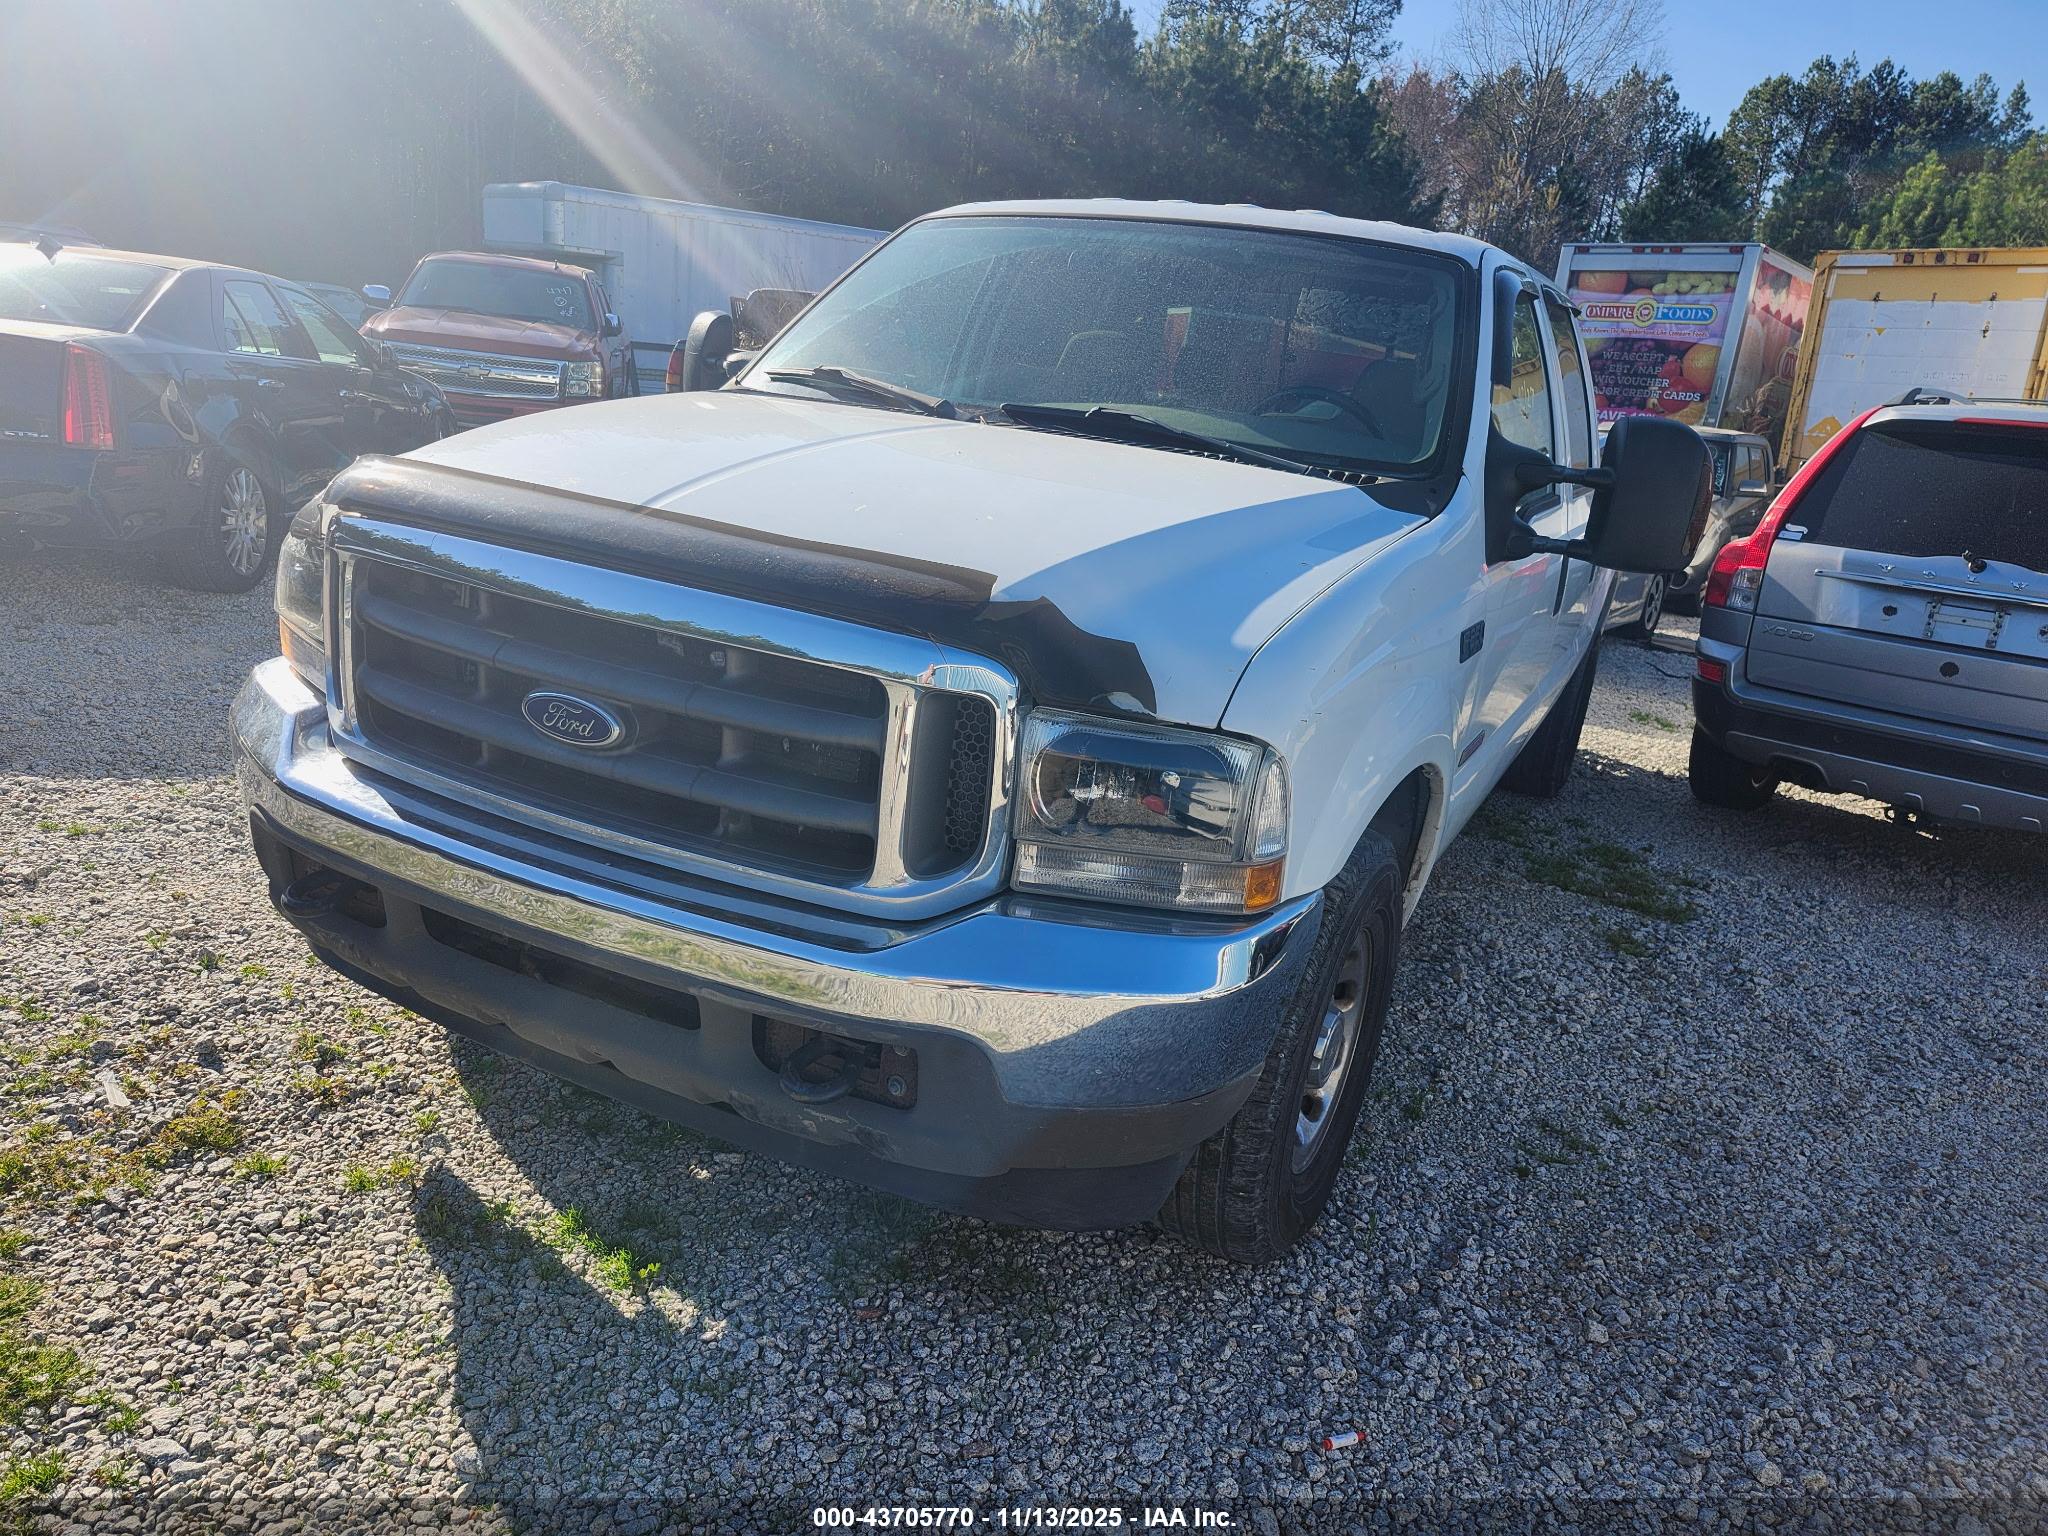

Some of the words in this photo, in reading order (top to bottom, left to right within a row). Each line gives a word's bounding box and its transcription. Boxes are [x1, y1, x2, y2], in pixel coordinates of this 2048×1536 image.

[1656, 303, 1710, 321] FOODS
[1602, 351, 1619, 360] WE
[1608, 364, 1630, 373] EBT
[1595, 374, 1615, 384] WIC
[1617, 376, 1669, 387] VOUCHER
[1593, 386, 1621, 396] AJOR
[1623, 387, 1663, 399] CREDIT
[1663, 391, 1701, 402] CARDS
[543, 702, 596, 737] Ford
